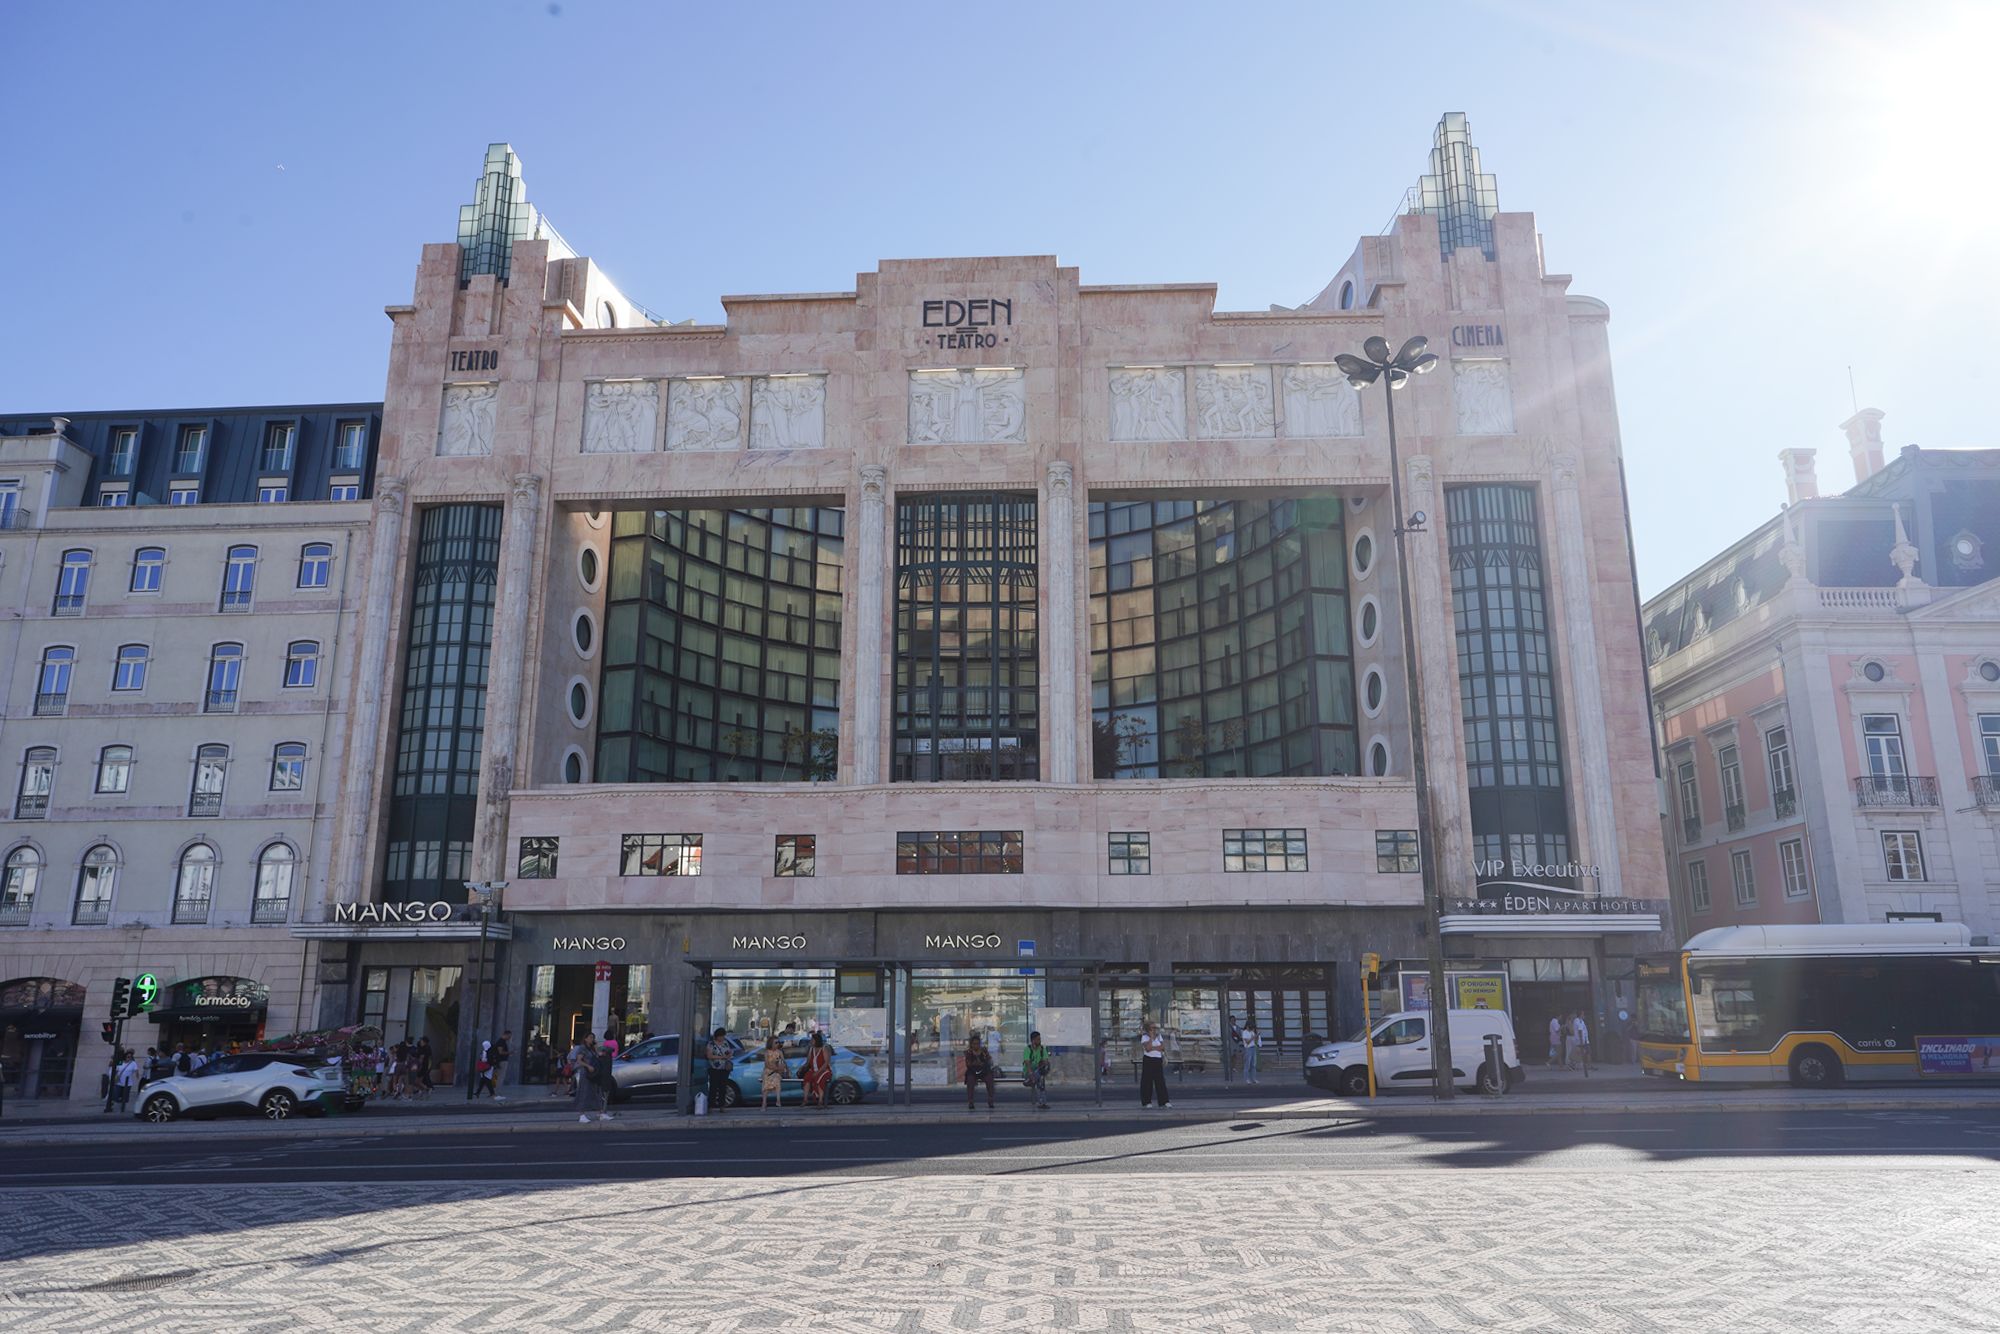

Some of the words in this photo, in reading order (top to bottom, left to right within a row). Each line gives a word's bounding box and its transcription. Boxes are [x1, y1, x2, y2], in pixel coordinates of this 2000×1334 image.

[923, 299, 1011, 327] EDEN
[937, 334, 997, 349] TEATRO
[1452, 324, 1504, 346] CINEMA
[451, 350, 498, 371] TEATRO
[1472, 860, 1504, 877] VIP
[1512, 860, 1601, 878] Executive
[1504, 893, 1550, 911] ÉDEN
[1554, 902, 1646, 911] APARTHOTEL
[334, 901, 452, 921] MANGO
[553, 937, 626, 950] MANGO
[733, 936, 807, 950] MANGO
[926, 935, 1001, 948] MANGO
[195, 993, 251, 1009] farmácia
[1857, 1038, 1882, 1048] carris
[1920, 1044, 1976, 1053] INCLINADO
